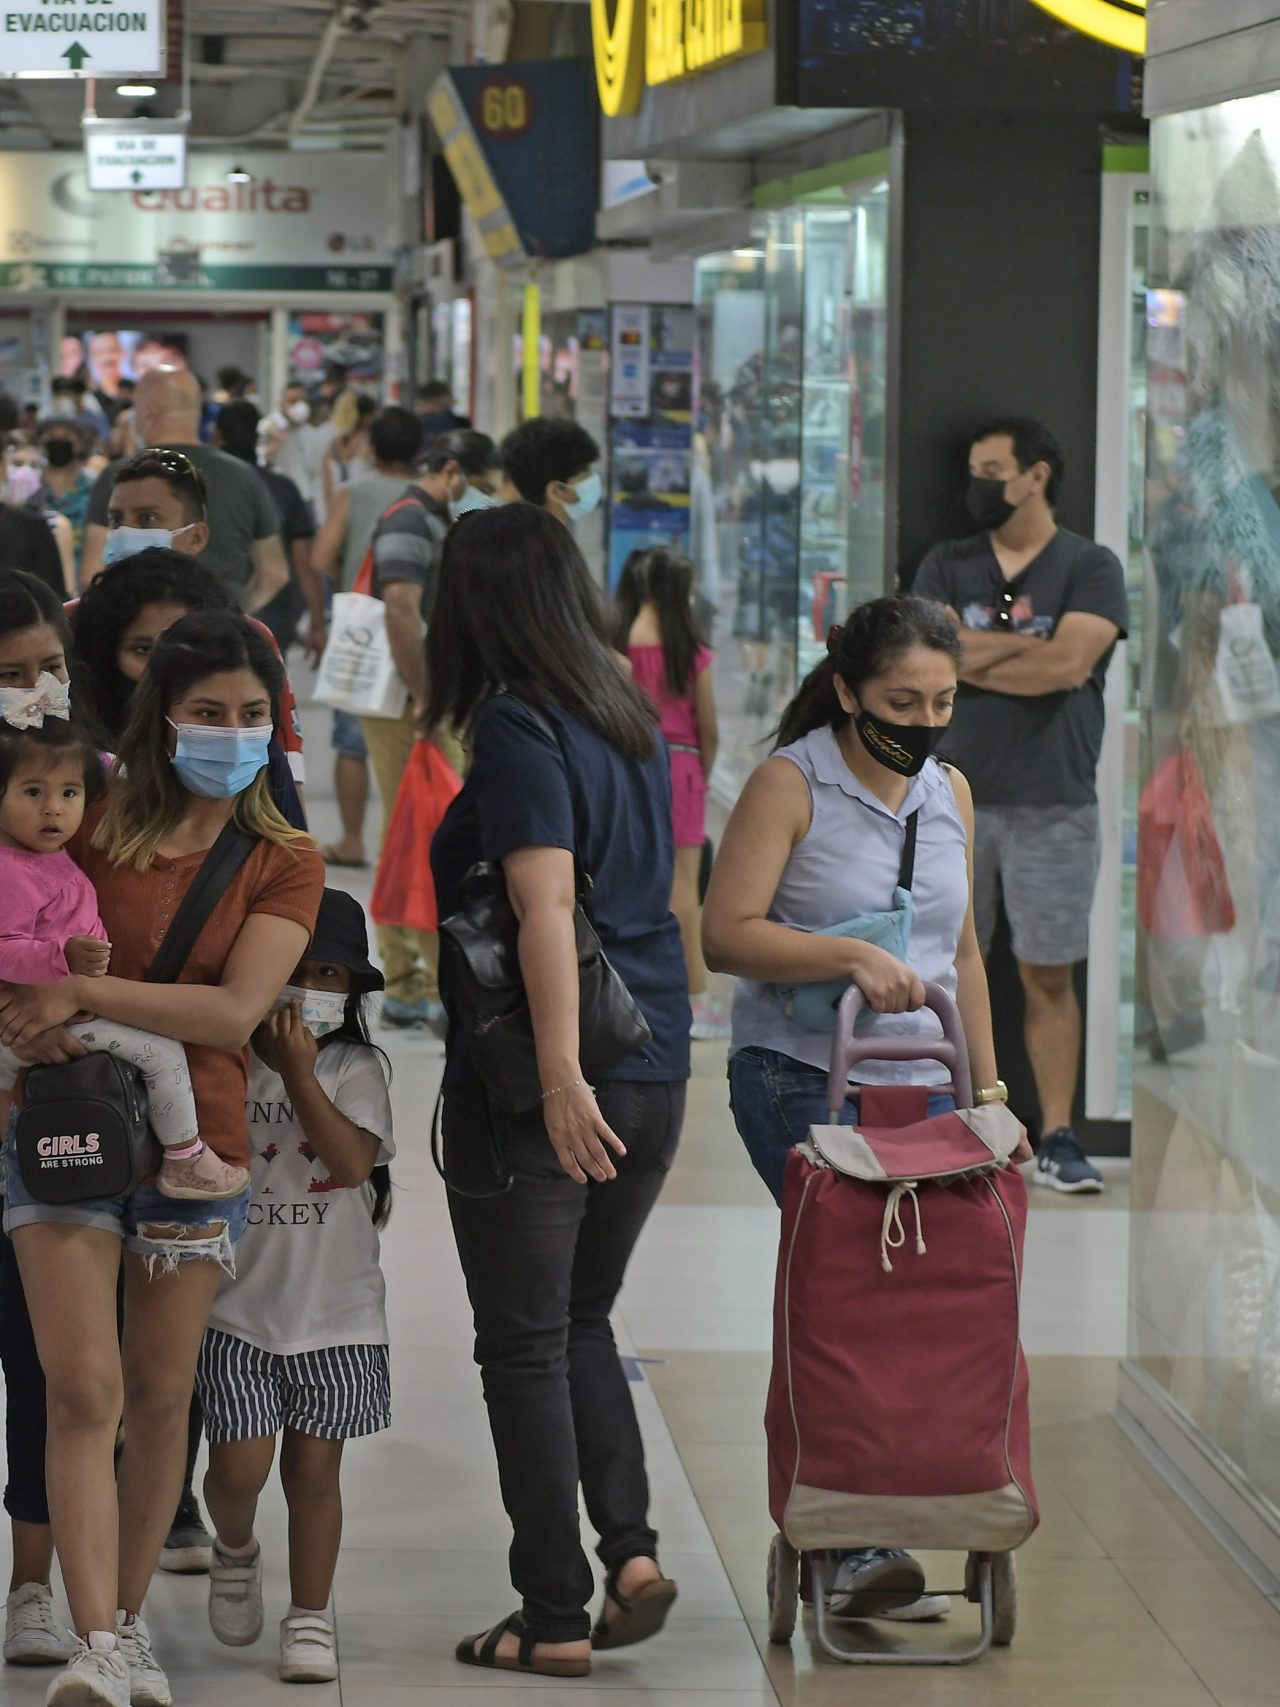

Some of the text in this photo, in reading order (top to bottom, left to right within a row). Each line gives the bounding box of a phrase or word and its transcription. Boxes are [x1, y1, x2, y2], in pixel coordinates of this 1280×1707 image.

[6, 13, 147, 32] EVACUACION
[483, 85, 526, 130] 60
[37, 1132, 100, 1157] GIRLS
[40, 1156, 104, 1169] ARE STRONG
[246, 1202, 330, 1226] CKEY
